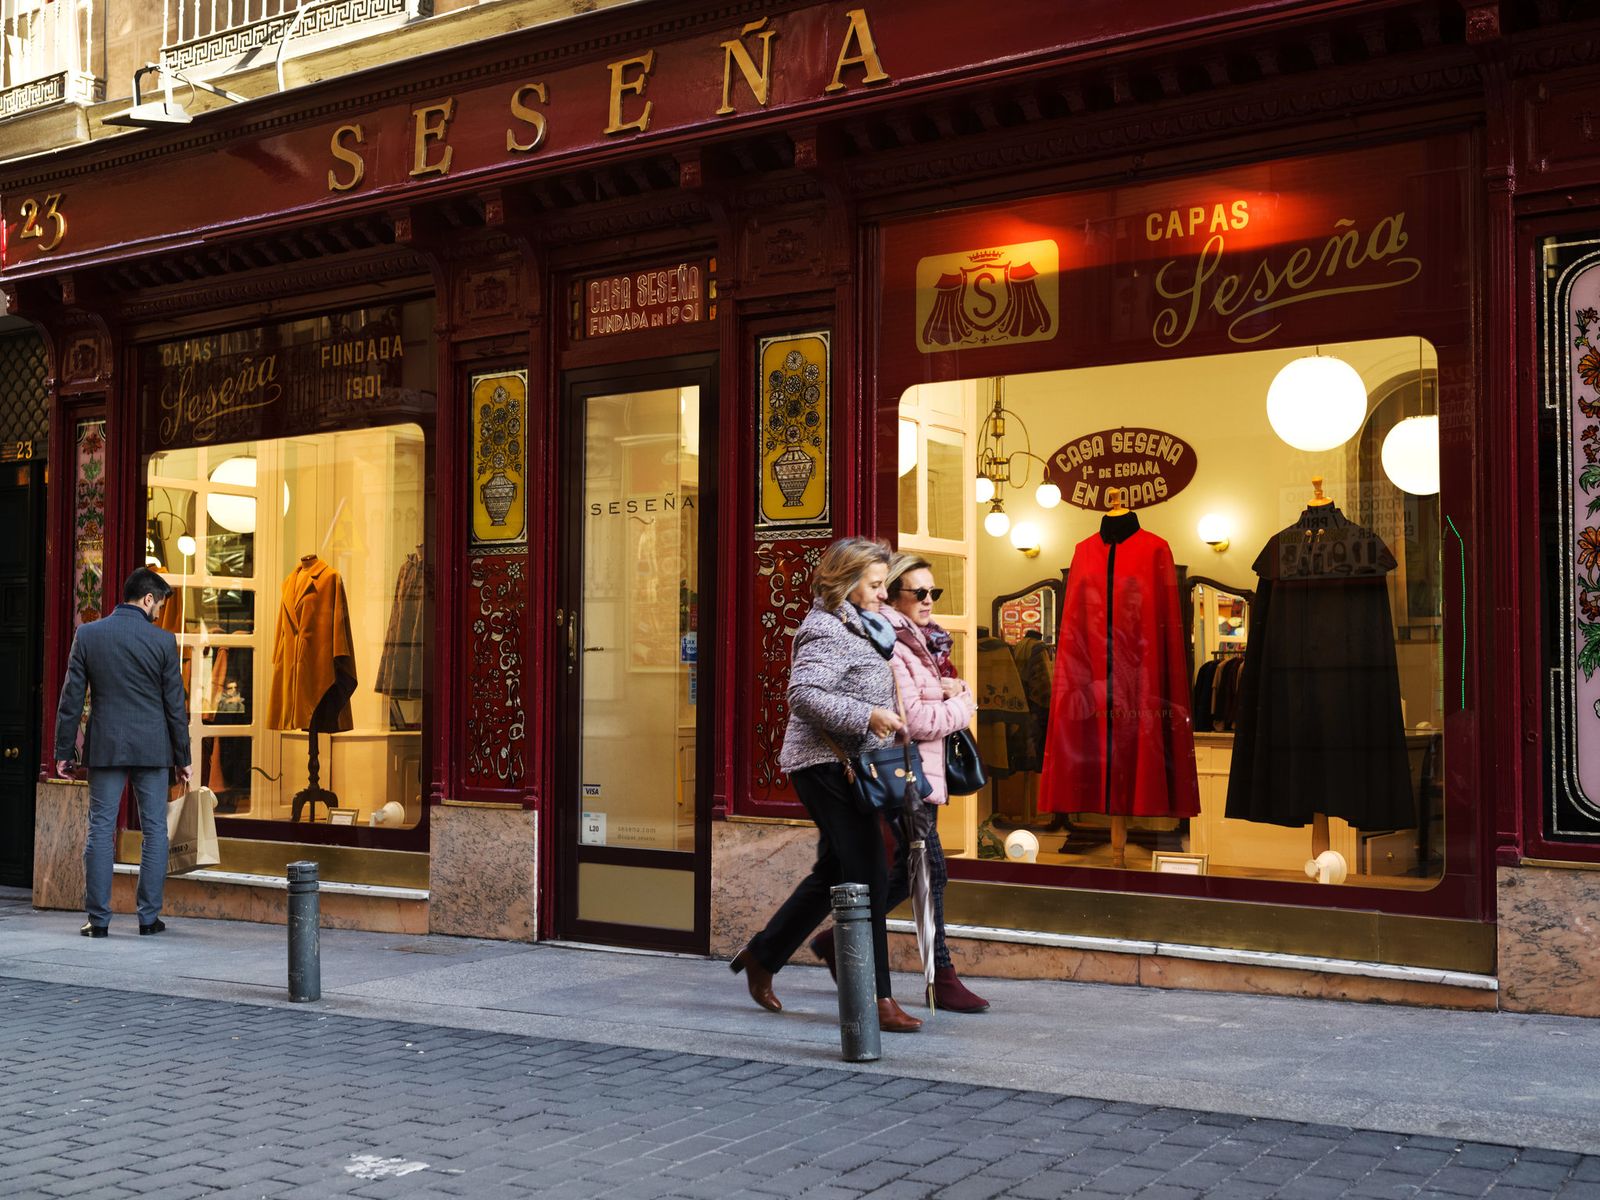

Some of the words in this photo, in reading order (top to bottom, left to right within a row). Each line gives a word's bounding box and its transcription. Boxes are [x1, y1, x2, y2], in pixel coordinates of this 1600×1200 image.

[328, 8, 890, 192] SESEÑA
[20, 193, 66, 251] 23
[1146, 200, 1250, 242] CAPAS
[590, 277, 631, 313] CASA
[637, 263, 699, 307] SESEÑA
[973, 272, 998, 321] S
[1152, 211, 1422, 348] Seseña
[590, 310, 649, 335] FUNDADA
[651, 312, 664, 327] EN
[666, 302, 699, 325] 1901
[162, 341, 212, 367] CAPAS
[321, 334, 404, 368] FUNDADA
[159, 353, 283, 445] Seseña
[345, 373, 382, 401] 1901
[16, 440, 33, 459] 23
[1055, 435, 1105, 473] CASA
[1111, 432, 1184, 466] SESEÑA
[1098, 467, 1112, 478] DE
[1114, 460, 1161, 478] ESPAÑA
[591, 493, 694, 516] SESEÑA
[1071, 481, 1100, 508] EN
[589, 825, 600, 833] L20
